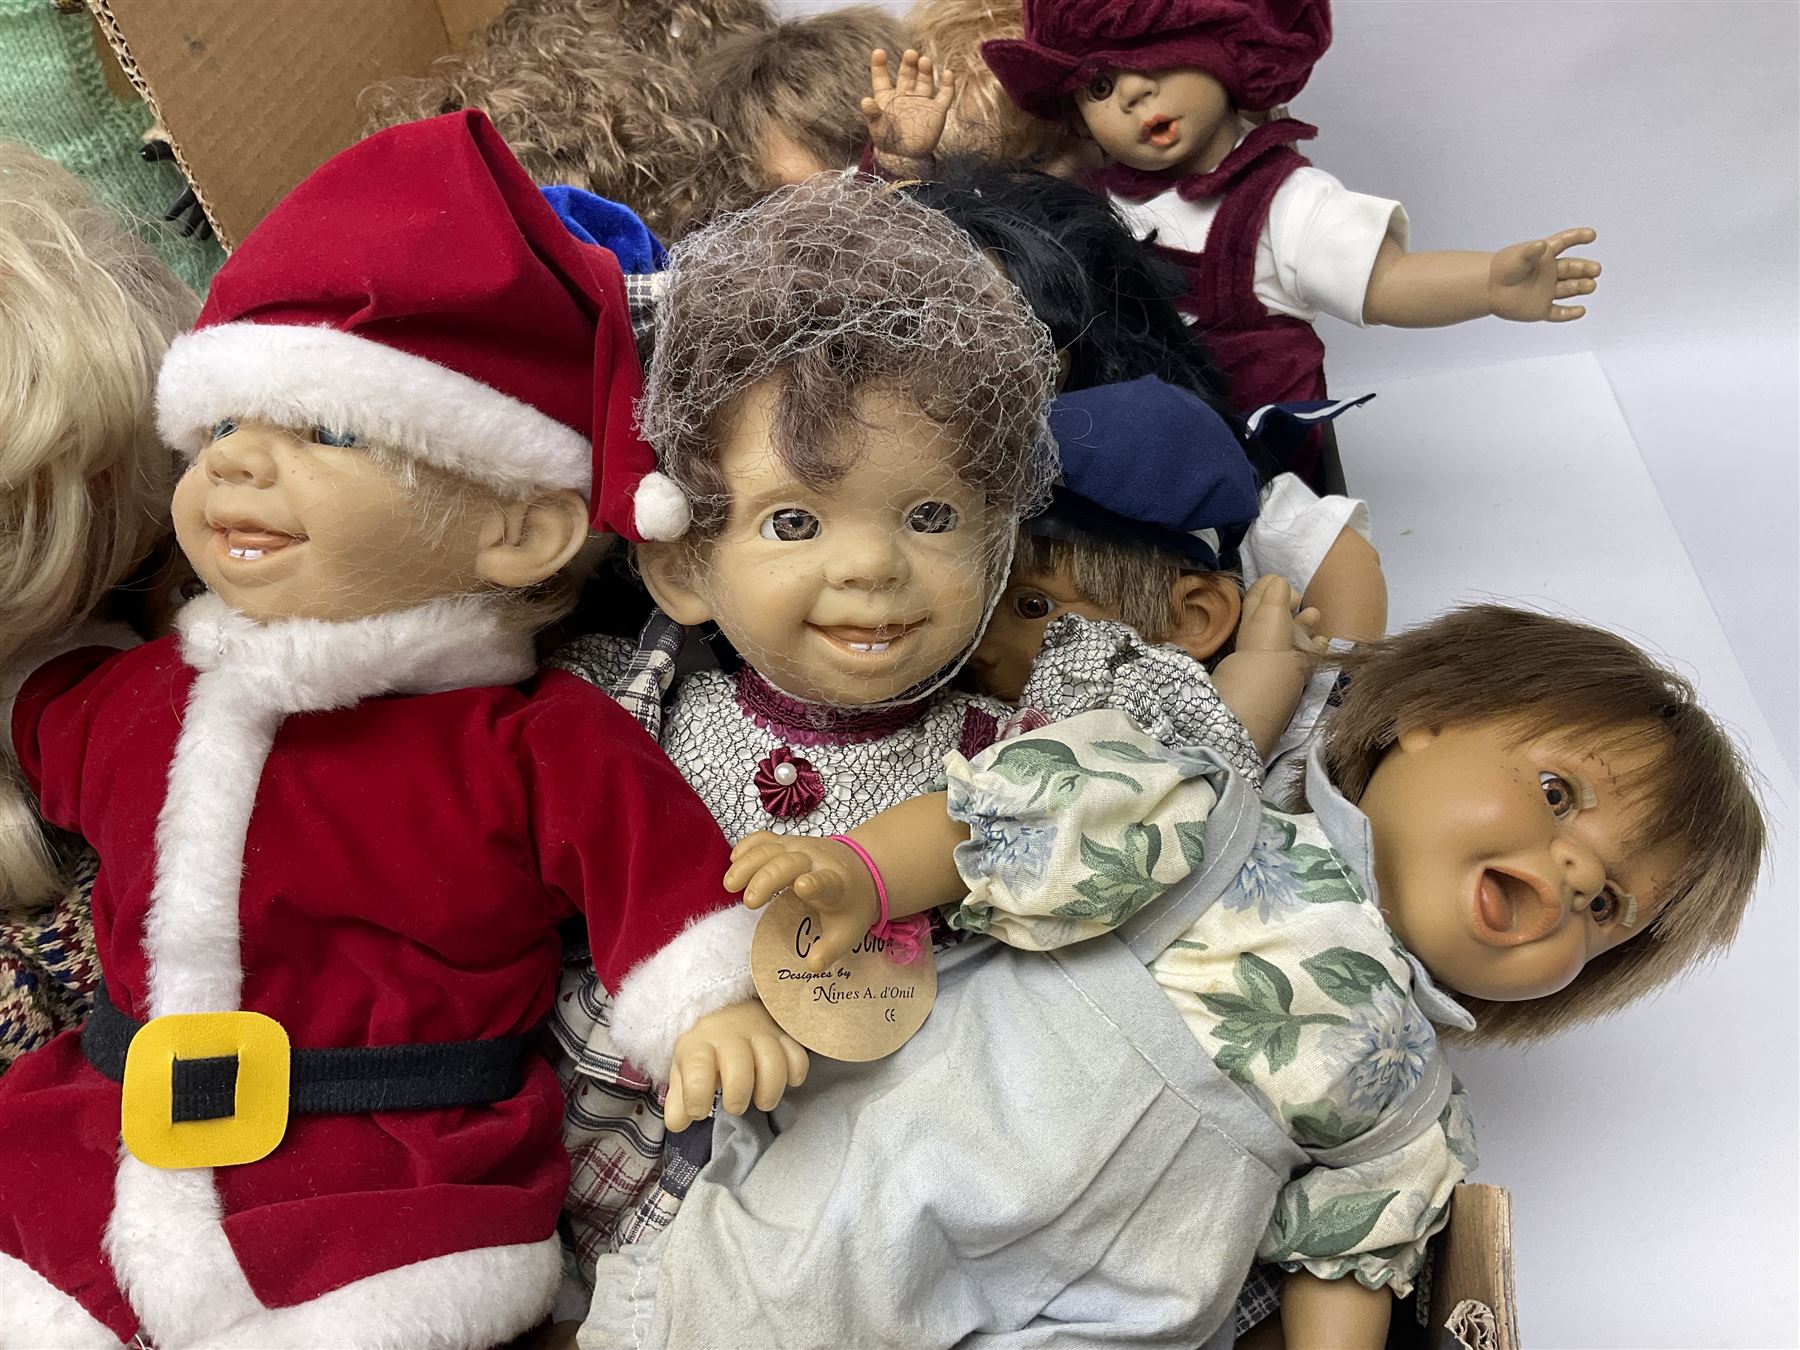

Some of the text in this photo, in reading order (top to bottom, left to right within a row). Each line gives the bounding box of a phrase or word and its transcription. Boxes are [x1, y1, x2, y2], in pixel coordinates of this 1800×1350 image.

[777, 967, 852, 982] Designes by
[813, 982, 915, 1004] Nines A. d'Onil
[885, 1008, 896, 1022] CE
